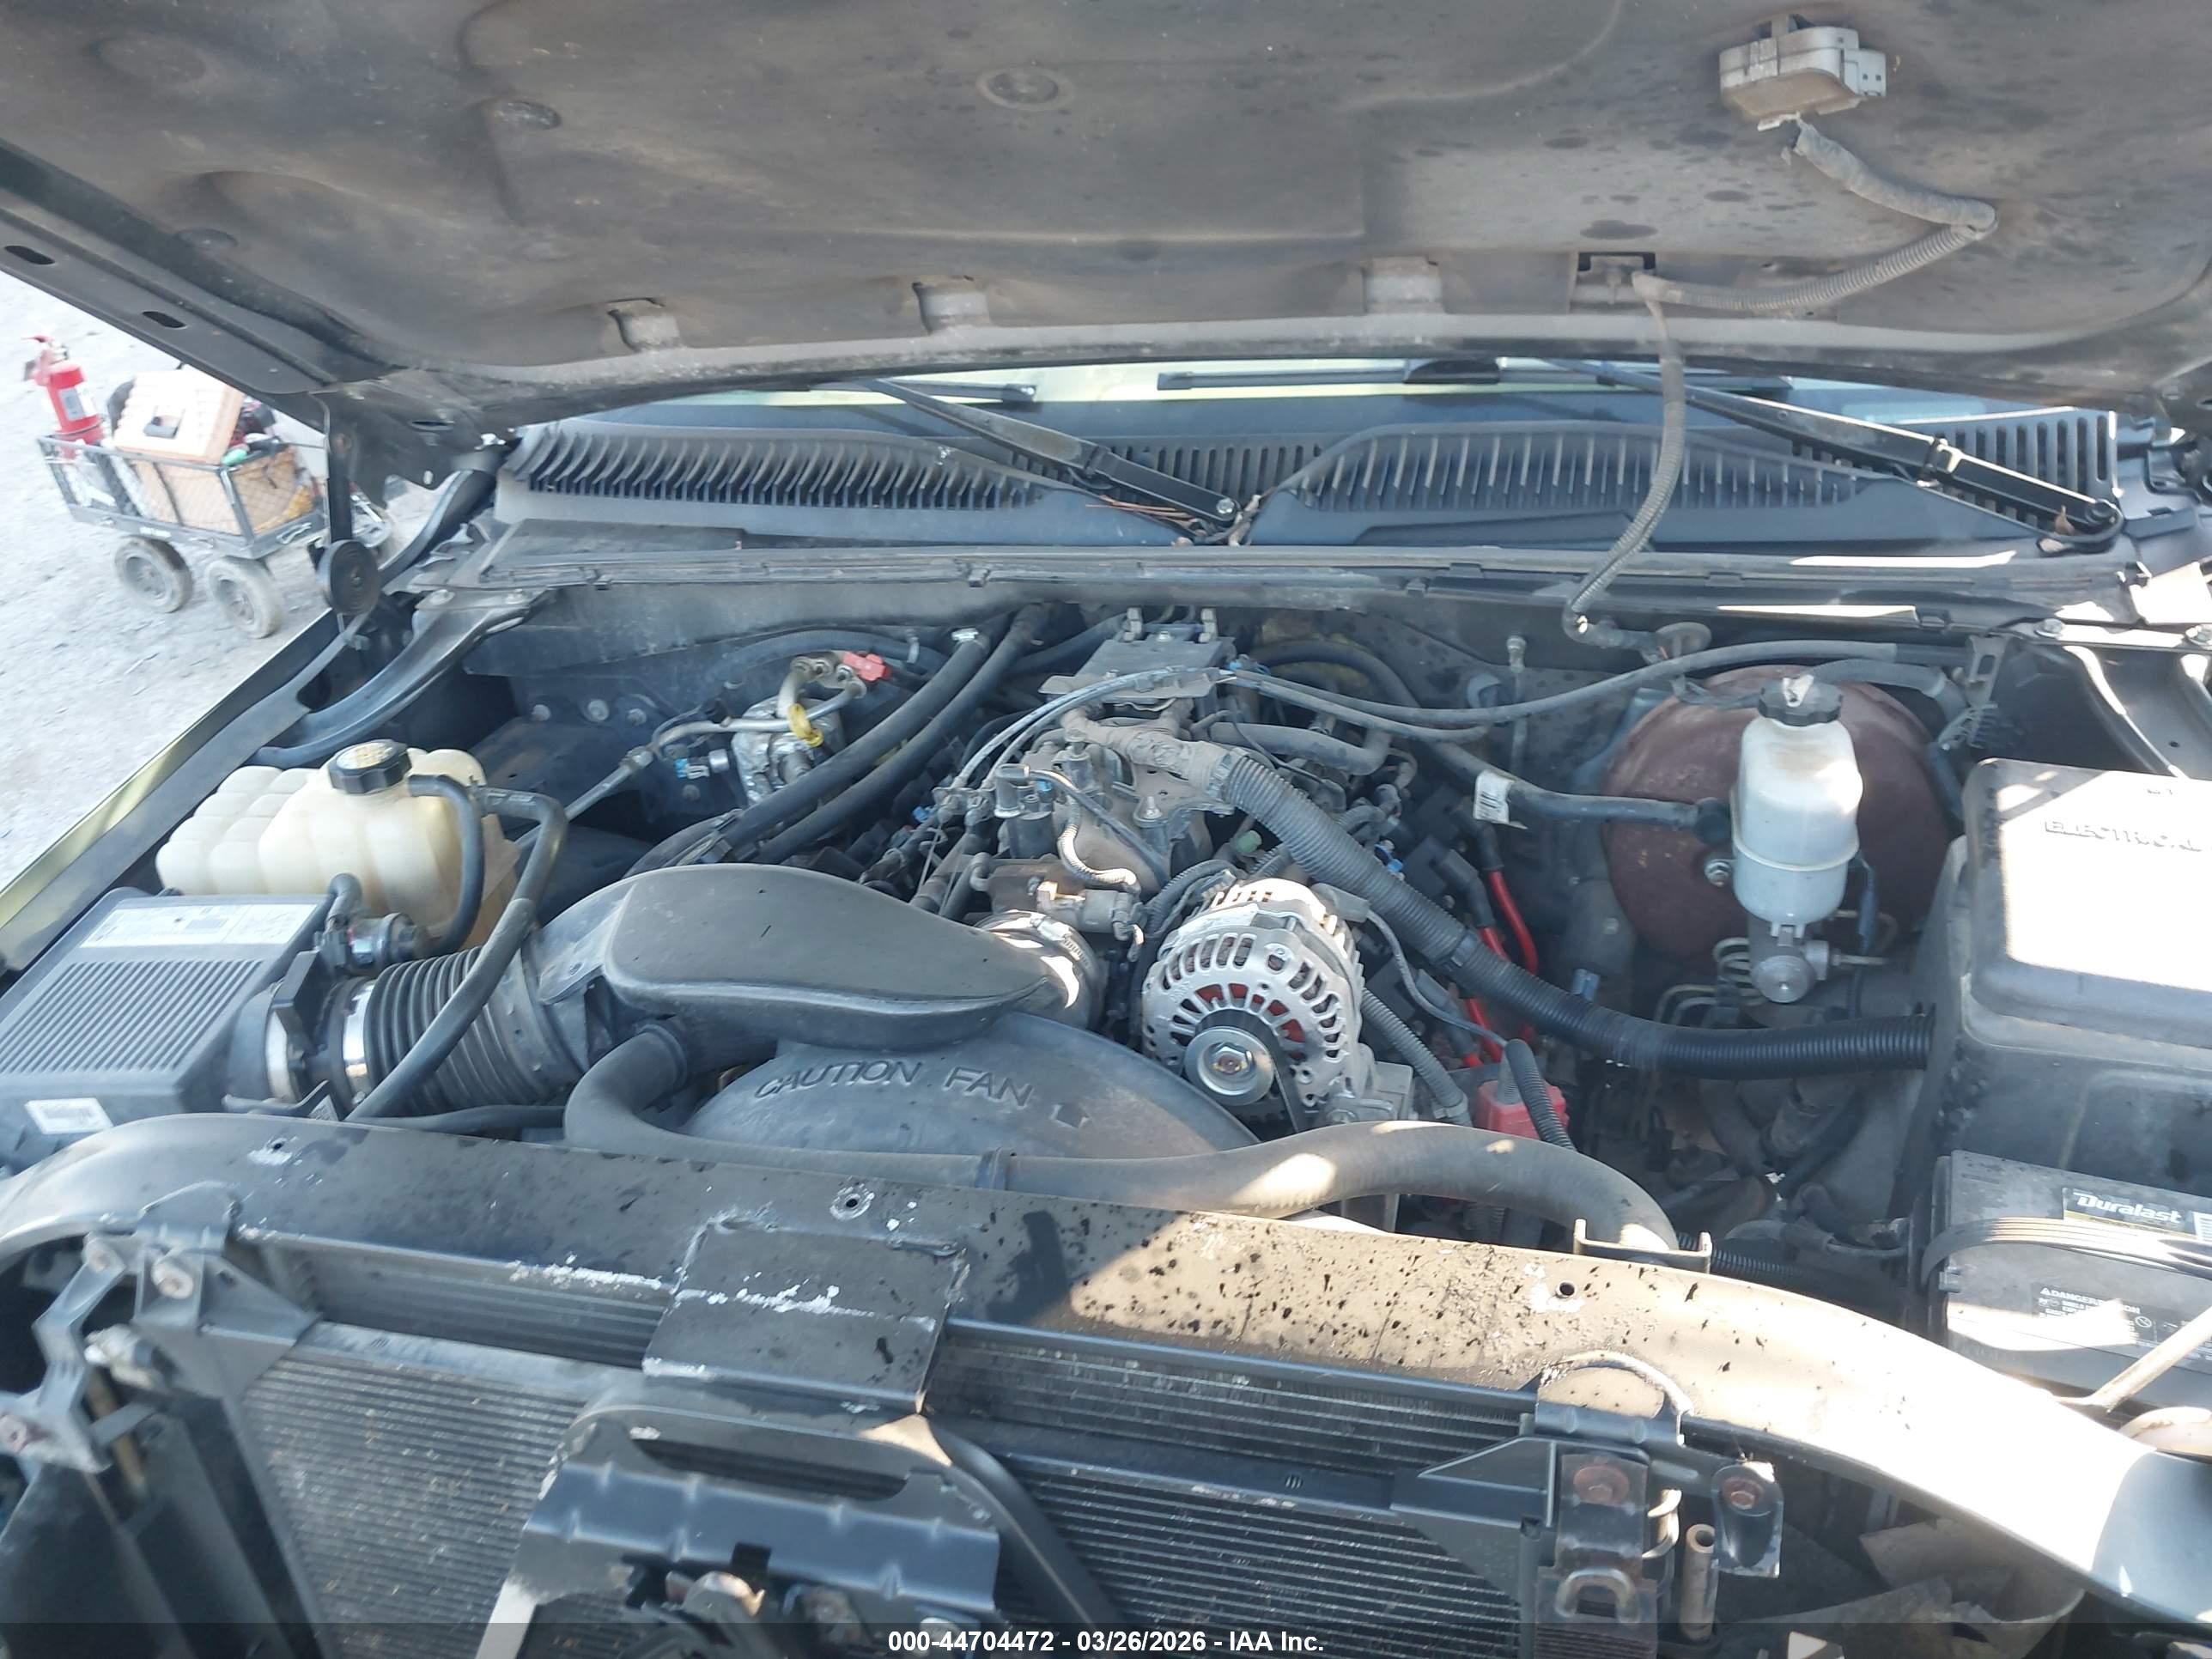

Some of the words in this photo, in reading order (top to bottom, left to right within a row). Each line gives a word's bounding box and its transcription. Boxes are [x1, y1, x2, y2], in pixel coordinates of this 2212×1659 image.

[754, 1059, 923, 1100] CAUTION
[942, 1066, 1035, 1109] FAN
[2073, 1191, 2182, 1224] Duralast
